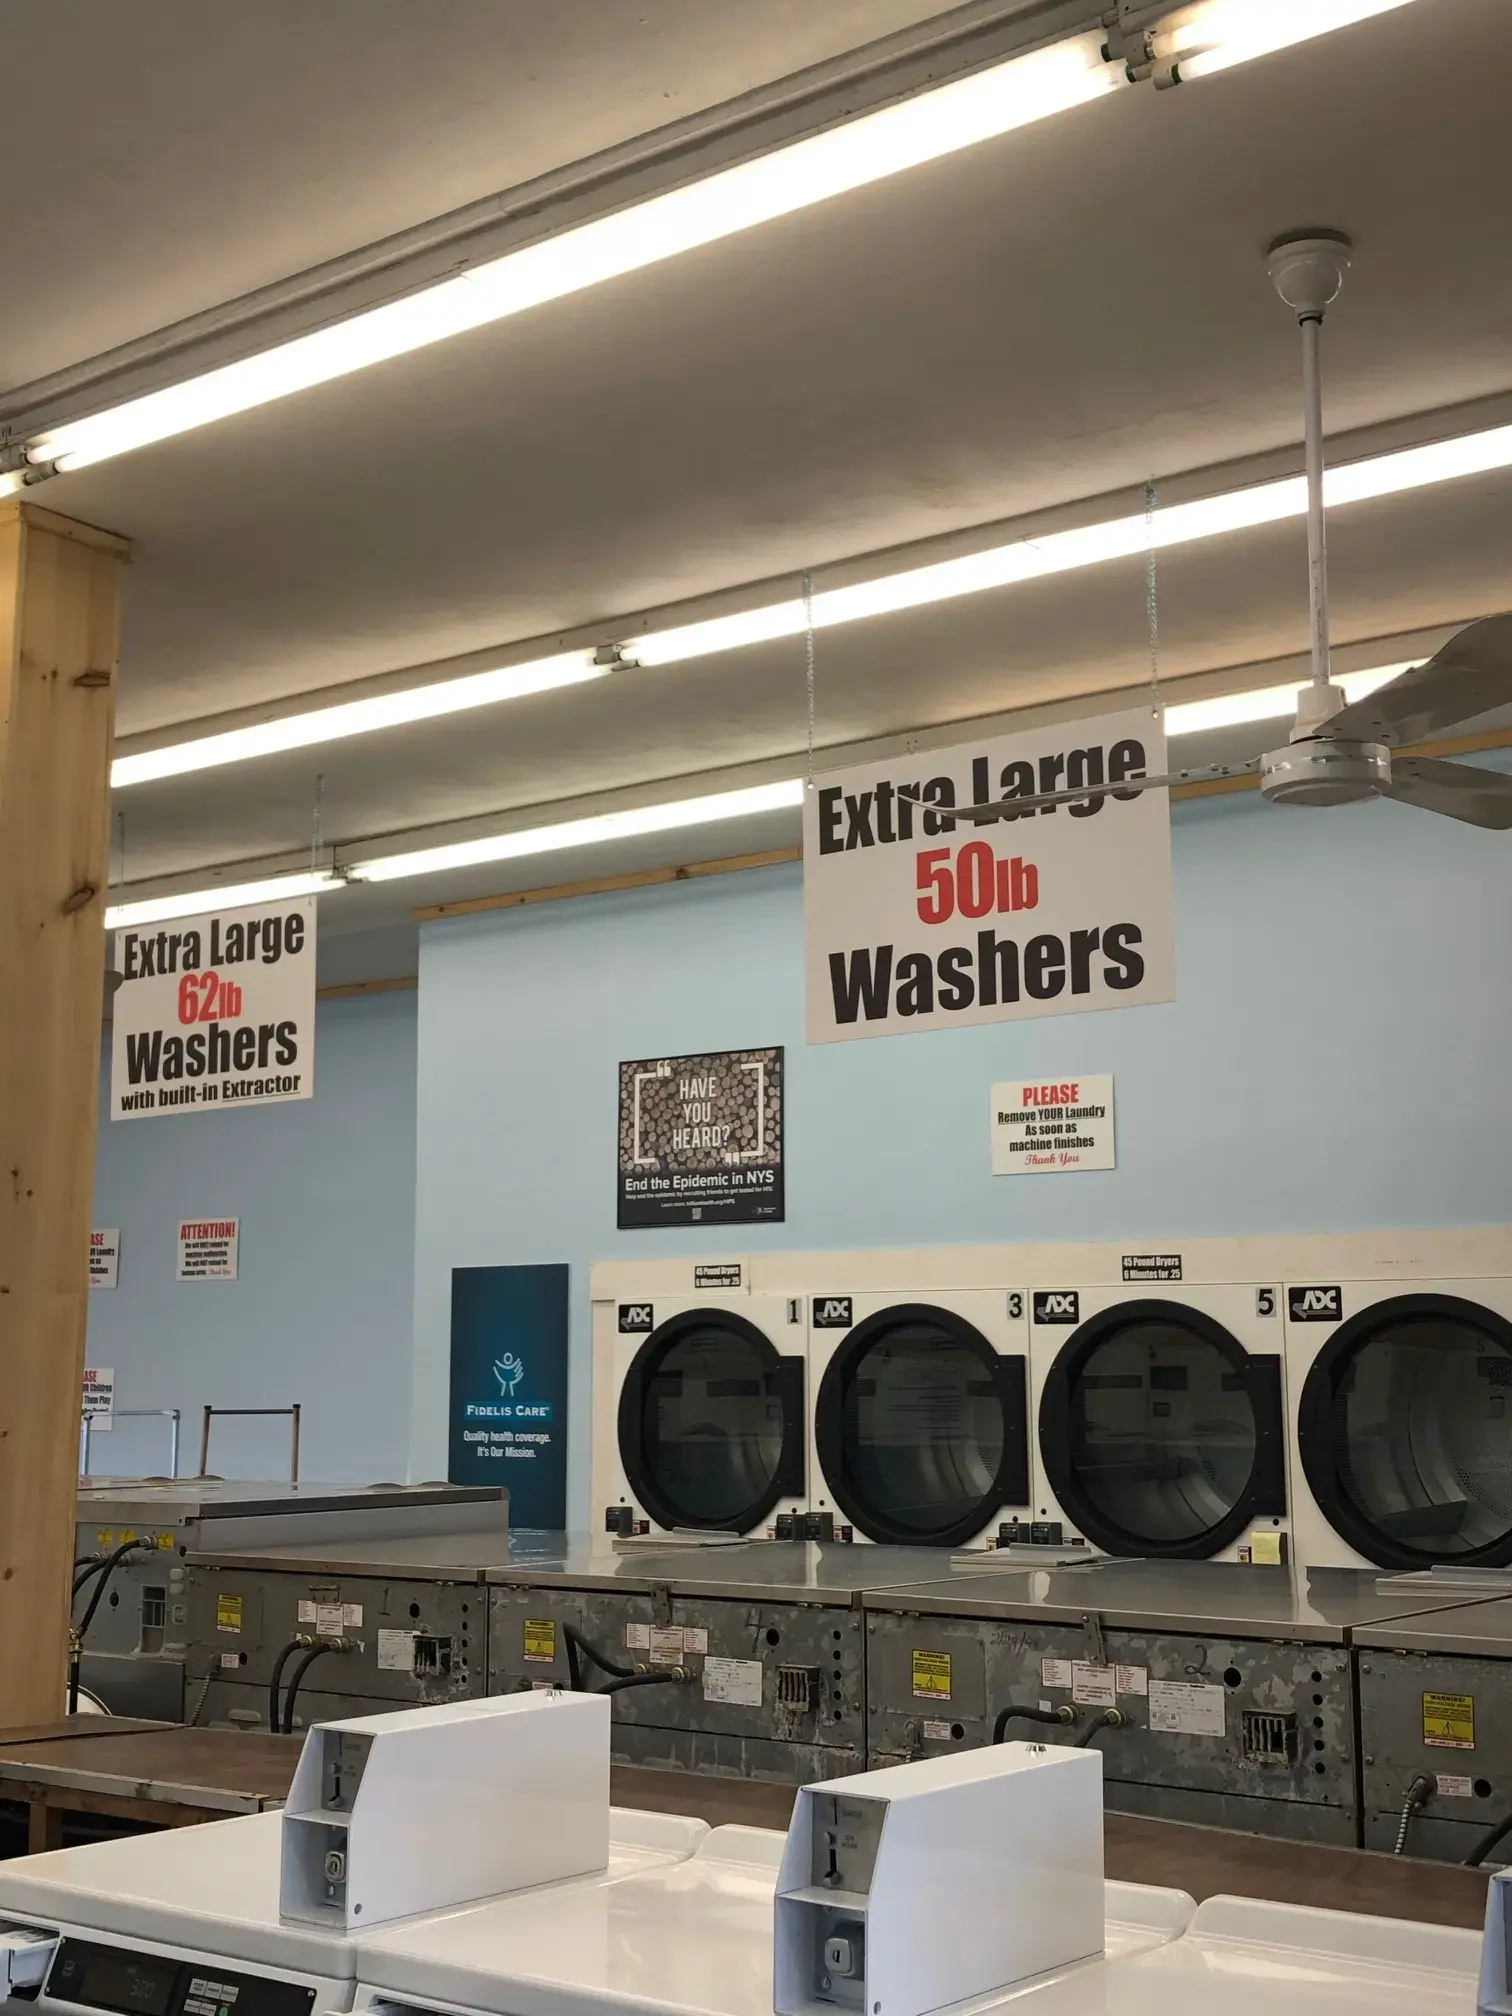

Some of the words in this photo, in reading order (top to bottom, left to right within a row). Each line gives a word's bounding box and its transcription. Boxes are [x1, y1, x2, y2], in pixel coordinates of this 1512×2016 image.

[818, 776, 956, 855] Extra
[972, 739, 1147, 827] Large
[916, 841, 1039, 925] 50lb
[124, 929, 201, 980] Extra
[210, 913, 304, 966] Large
[828, 923, 1145, 1025] Washers
[178, 970, 242, 1025] 62lb
[126, 1020, 297, 1085] Washers
[121, 1089, 155, 1111] with
[158, 1083, 218, 1107] built-in
[222, 1074, 301, 1100] Extractor
[679, 1076, 717, 1100] HAVE
[1023, 1084, 1079, 1106] PLEASE
[683, 1101, 711, 1124] YOU
[998, 1111, 1036, 1124] Remove
[1038, 1107, 1063, 1120] YOUR
[1065, 1105, 1105, 1118] Laundry
[672, 1125, 731, 1150] HEARD?
[1025, 1125, 1037, 1136] As
[1039, 1124, 1063, 1135] soon
[1065, 1123, 1077, 1133] as
[1010, 1138, 1052, 1152] machine
[1054, 1136, 1095, 1149] finishes
[1025, 1153, 1055, 1165] Thank
[1058, 1152, 1080, 1166] You
[625, 1178, 648, 1191] End
[650, 1177, 670, 1189] the
[673, 1174, 728, 1191] Epidemic
[732, 1172, 743, 1185] in
[746, 1170, 775, 1184] NYS
[180, 1221, 235, 1240] ATTENTION!
[1124, 1257, 1132, 1266] 45
[1133, 1257, 1155, 1267] Pound
[1155, 1256, 1179, 1267] Dryers
[1130, 1270, 1157, 1279] Minutes
[1158, 1269, 1169, 1279] for
[823, 1300, 849, 1317] ADC
[1009, 1293, 1022, 1318] 3
[1045, 1295, 1074, 1313] ADC
[1257, 1288, 1274, 1315] 5
[1302, 1290, 1336, 1309] ADC
[627, 1306, 650, 1323] ADC
[790, 1300, 798, 1323] 1
[467, 1405, 512, 1416] FIDELIS
[464, 1430, 489, 1443] Quality
[491, 1431, 513, 1441] health
[515, 1433, 551, 1444] coverage.
[477, 1446, 489, 1456] It's
[491, 1446, 504, 1457] Our
[505, 1446, 536, 1458] Mission.
[1184, 1645, 1211, 1675] 2
